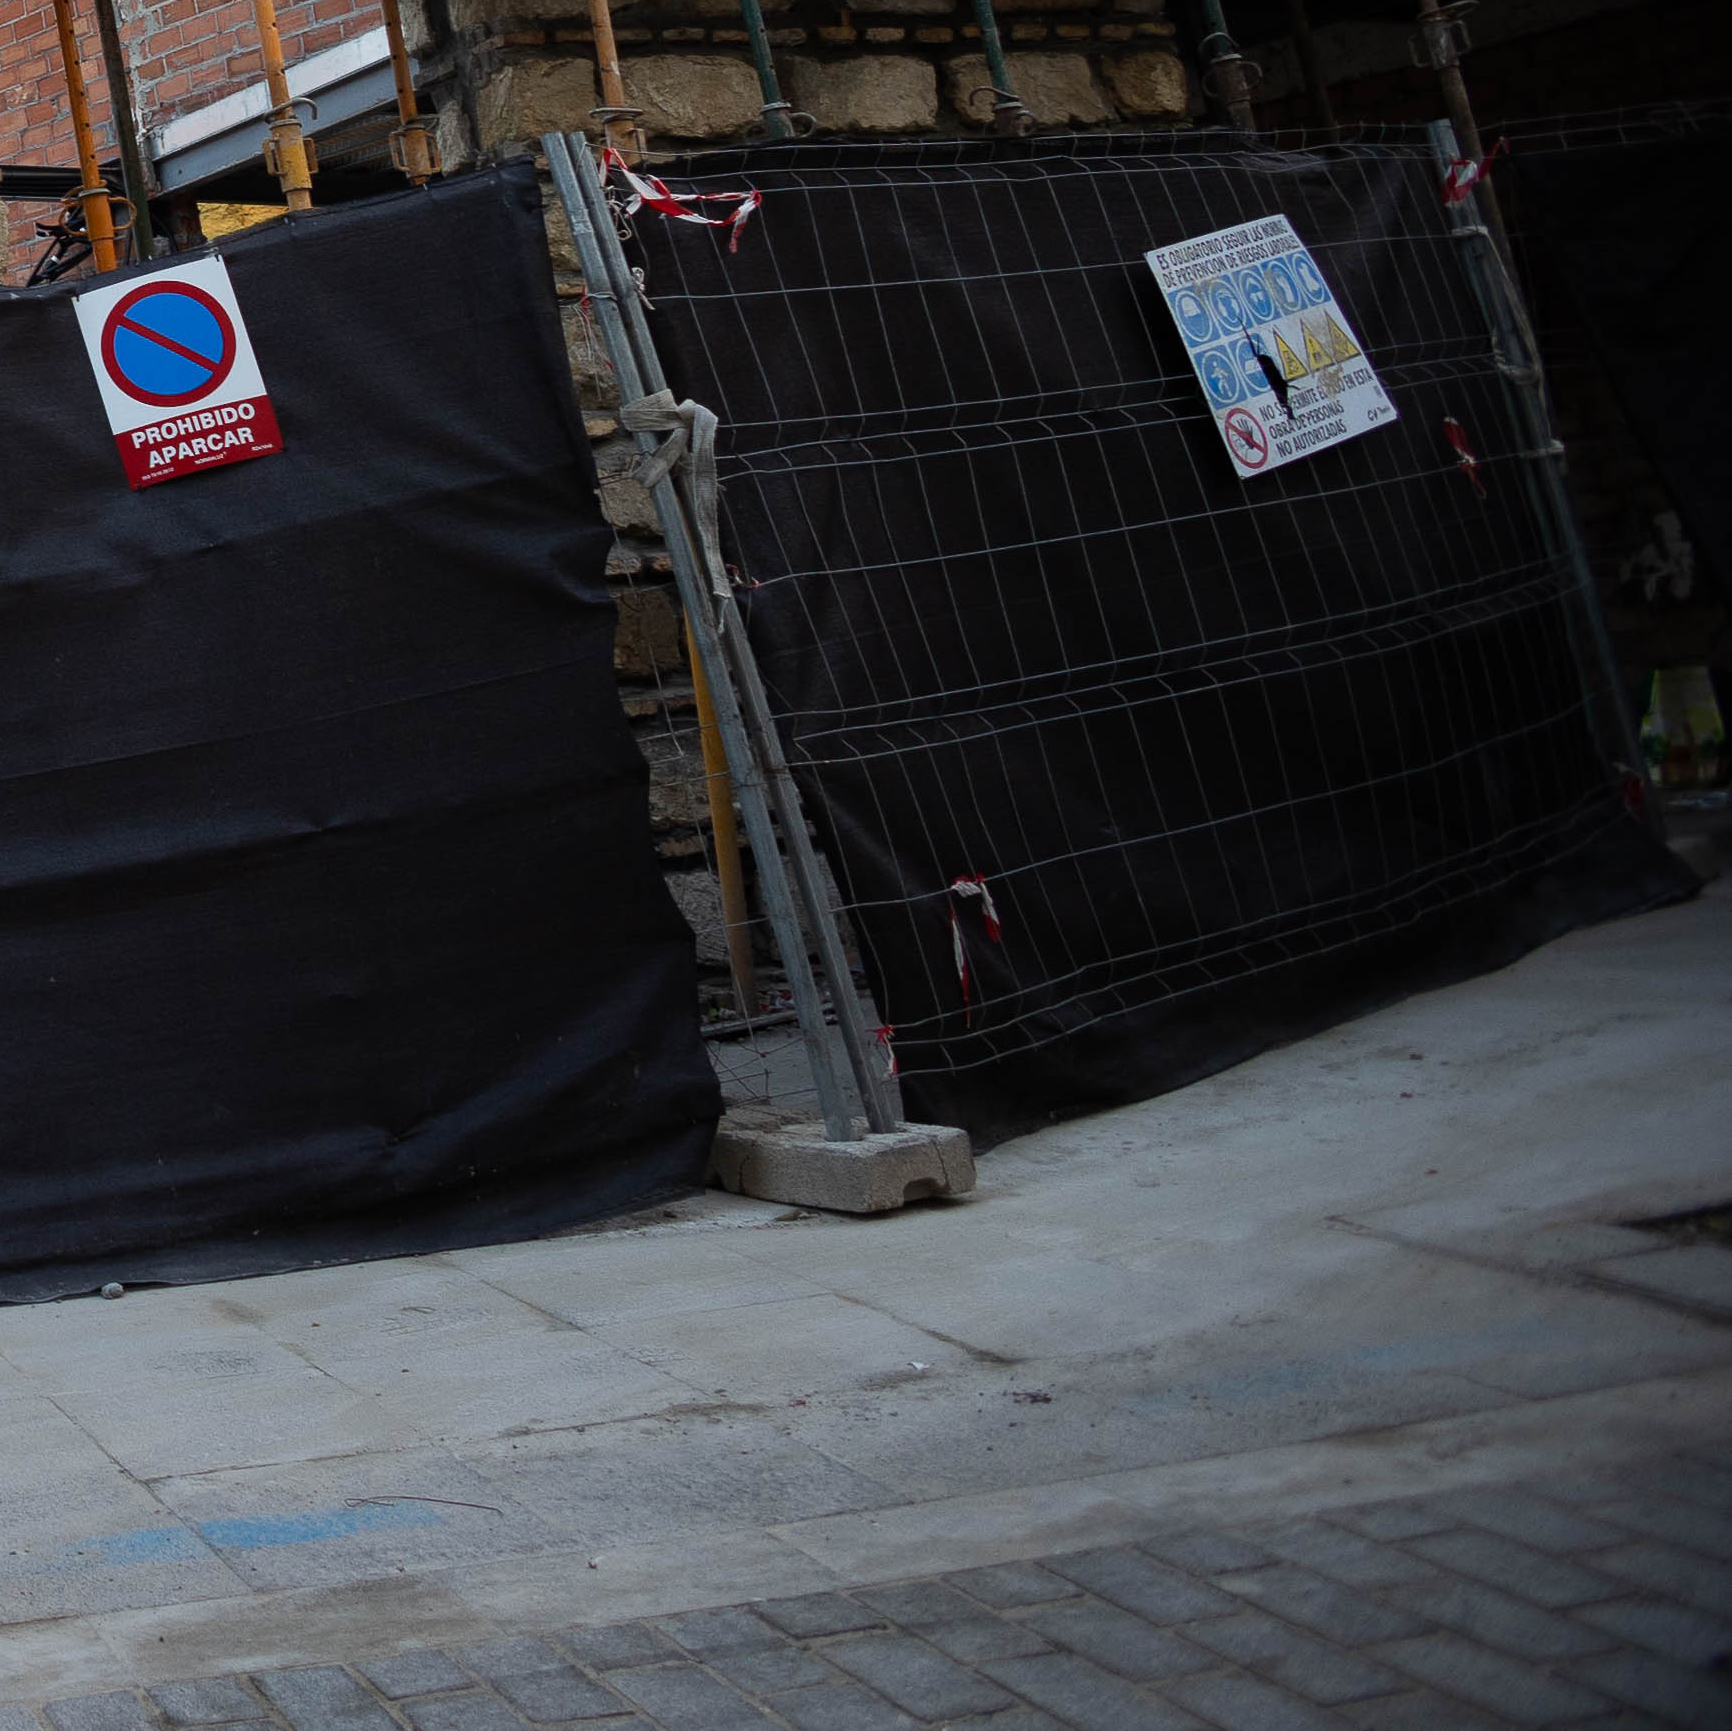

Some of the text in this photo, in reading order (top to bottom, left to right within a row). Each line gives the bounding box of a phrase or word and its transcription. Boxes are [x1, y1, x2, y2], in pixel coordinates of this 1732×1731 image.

[1156, 253, 1169, 270] ES
[1169, 238, 1223, 266] OBLIGATORIO
[1221, 230, 1252, 250] SEGUIR
[1162, 270, 1176, 288] DE
[1176, 256, 1226, 285] PREVENCION
[1225, 253, 1239, 268] DE
[1237, 244, 1267, 266] RIESGOS
[1259, 404, 1275, 421] NO
[1290, 388, 1319, 409] ERMITE
[1343, 374, 1355, 389] EN
[1352, 367, 1374, 385] ESTA
[131, 402, 256, 449] PROHIBIDO
[1268, 419, 1295, 440] OBRA
[1304, 400, 1345, 427] PERSONAS
[1276, 419, 1347, 458] NO AUTORIZADAS
[149, 427, 255, 468] APARCAR
